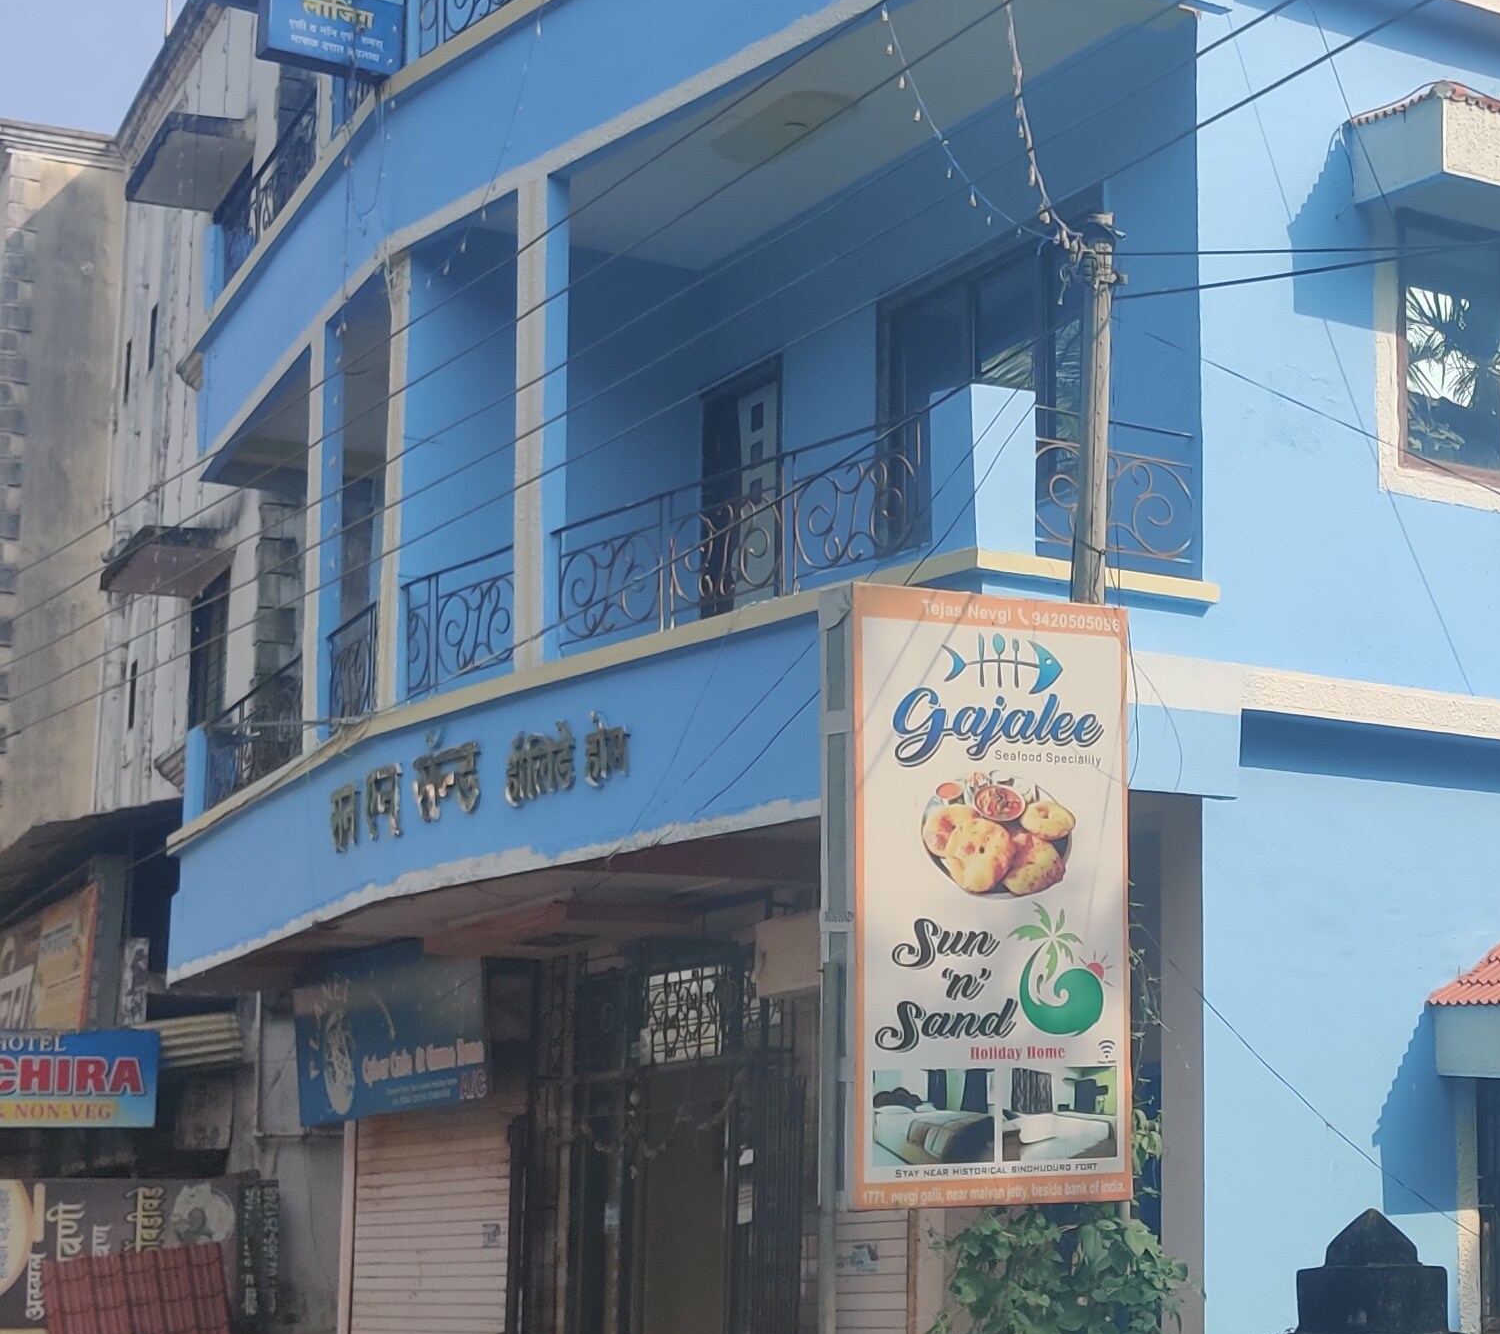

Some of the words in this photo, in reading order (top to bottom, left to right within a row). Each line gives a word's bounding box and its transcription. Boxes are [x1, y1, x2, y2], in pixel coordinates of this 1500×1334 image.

[921, 599, 962, 619] Tejas
[967, 605, 1011, 625] Nevgi
[1031, 611, 1121, 633] 9420505096
[892, 686, 1104, 767] Gajalee
[994, 749, 1042, 763] Seafood
[1045, 752, 1102, 767] Speciality
[892, 917, 1000, 971] Sun
[874, 998, 1019, 1053] Sand
[970, 1045, 1022, 1061] Holiday
[1026, 1045, 1066, 1060] Home
[923, 1167, 950, 1178] NEAR
[952, 1165, 1008, 1176] HISTORICAL
[1011, 1163, 1071, 1175] SINDHUDURG
[1074, 1162, 1098, 1172] FORT
[891, 1186, 919, 1207] nevgi
[947, 1188, 968, 1202] near
[970, 1184, 1005, 1200] malvan
[1032, 1182, 1062, 1197] beside
[1064, 1181, 1088, 1195] bank
[1090, 1180, 1100, 1194] of
